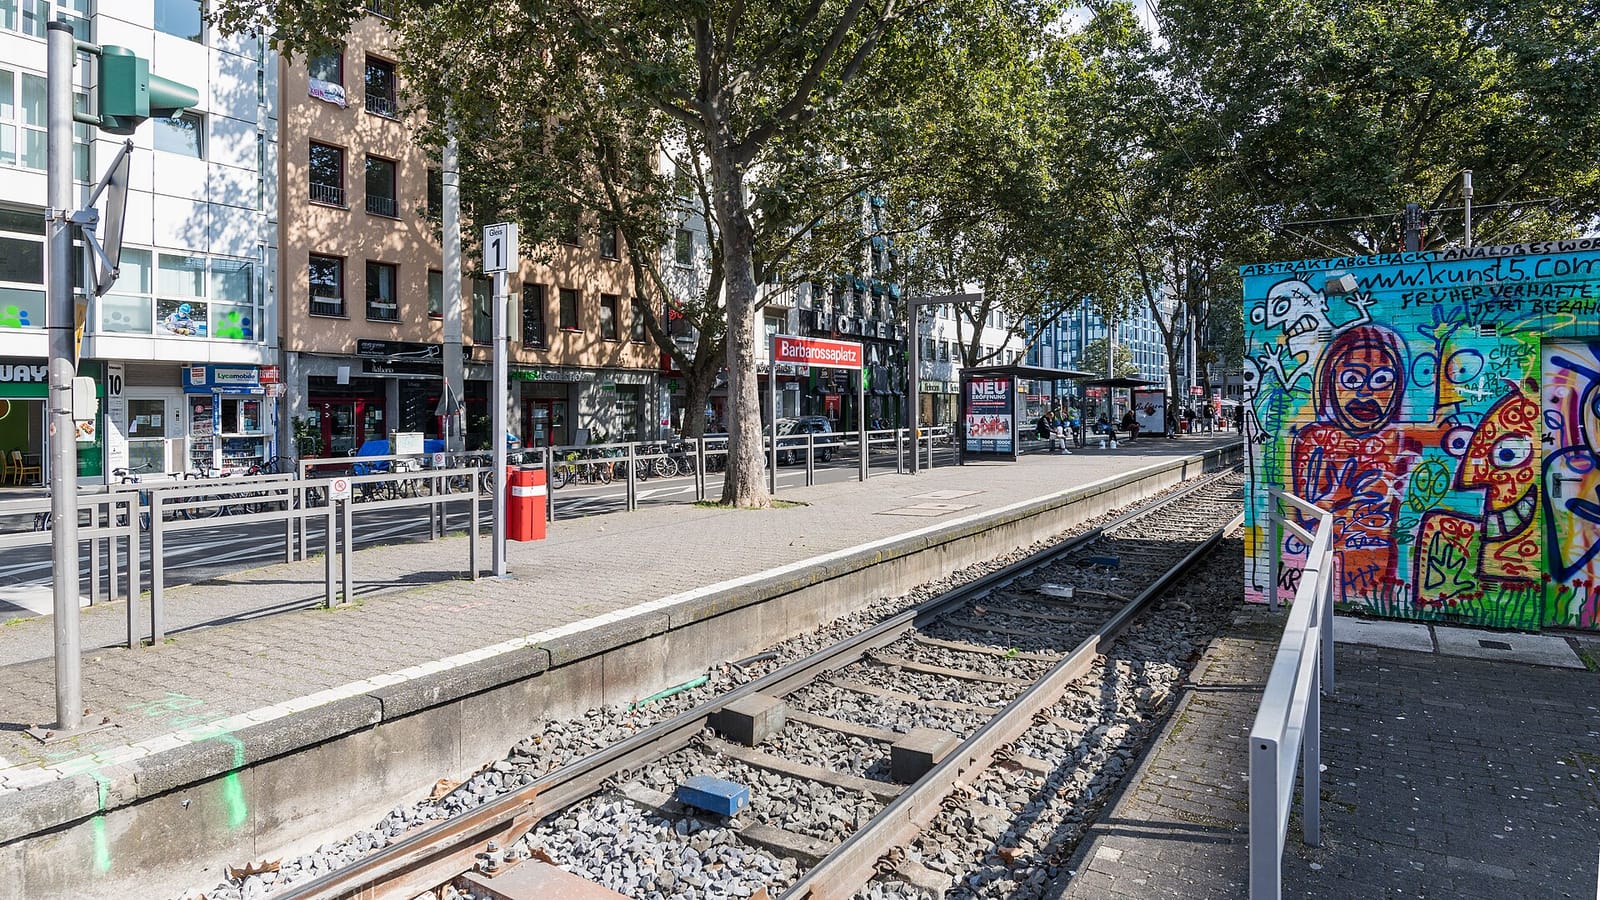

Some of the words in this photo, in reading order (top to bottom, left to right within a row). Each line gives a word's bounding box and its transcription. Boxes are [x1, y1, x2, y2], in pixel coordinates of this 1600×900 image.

[489, 228, 503, 237] Gleis
[492, 238, 501, 267] 1
[1401, 287, 1487, 310] FRÜHER
[1490, 283, 1600, 299] VERHAFTE
[1529, 300, 1600, 315] BEZAH
[817, 311, 903, 340] HOTEL
[781, 340, 857, 364] Barbarossaplatz
[1489, 343, 1536, 360] CHECK
[109, 375, 122, 395] 10
[217, 372, 256, 380] Lycamobile
[972, 382, 1006, 395] NEU
